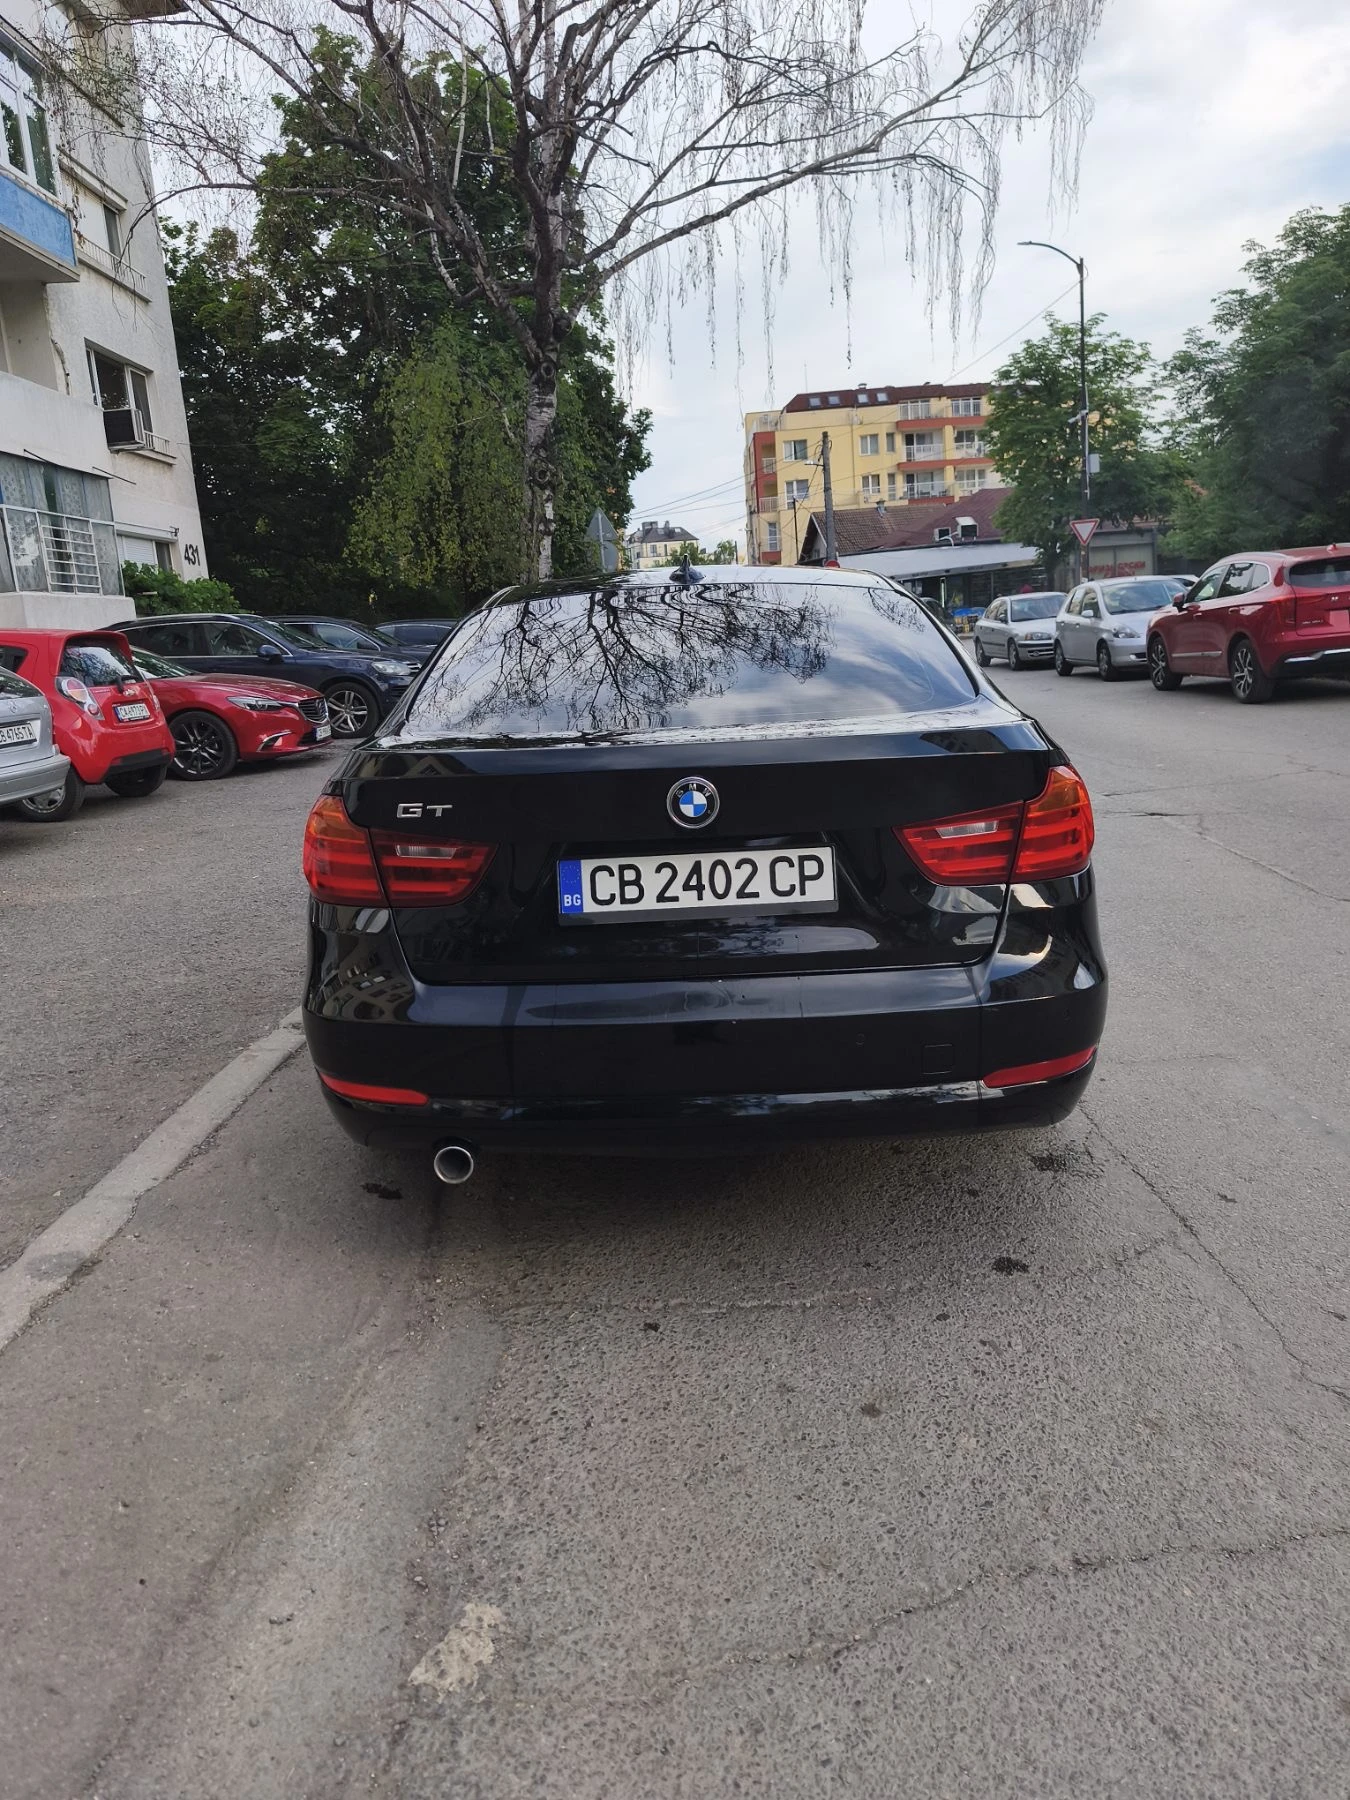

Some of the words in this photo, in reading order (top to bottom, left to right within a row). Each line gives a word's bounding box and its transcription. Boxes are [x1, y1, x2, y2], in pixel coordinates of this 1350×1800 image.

[184, 544, 200, 566] 431
[676, 783, 711, 798] BMW
[396, 803, 453, 818] GT
[590, 864, 645, 906] CB
[654, 858, 760, 903] 2402
[769, 854, 825, 897] CP
[564, 894, 582, 907] BG
